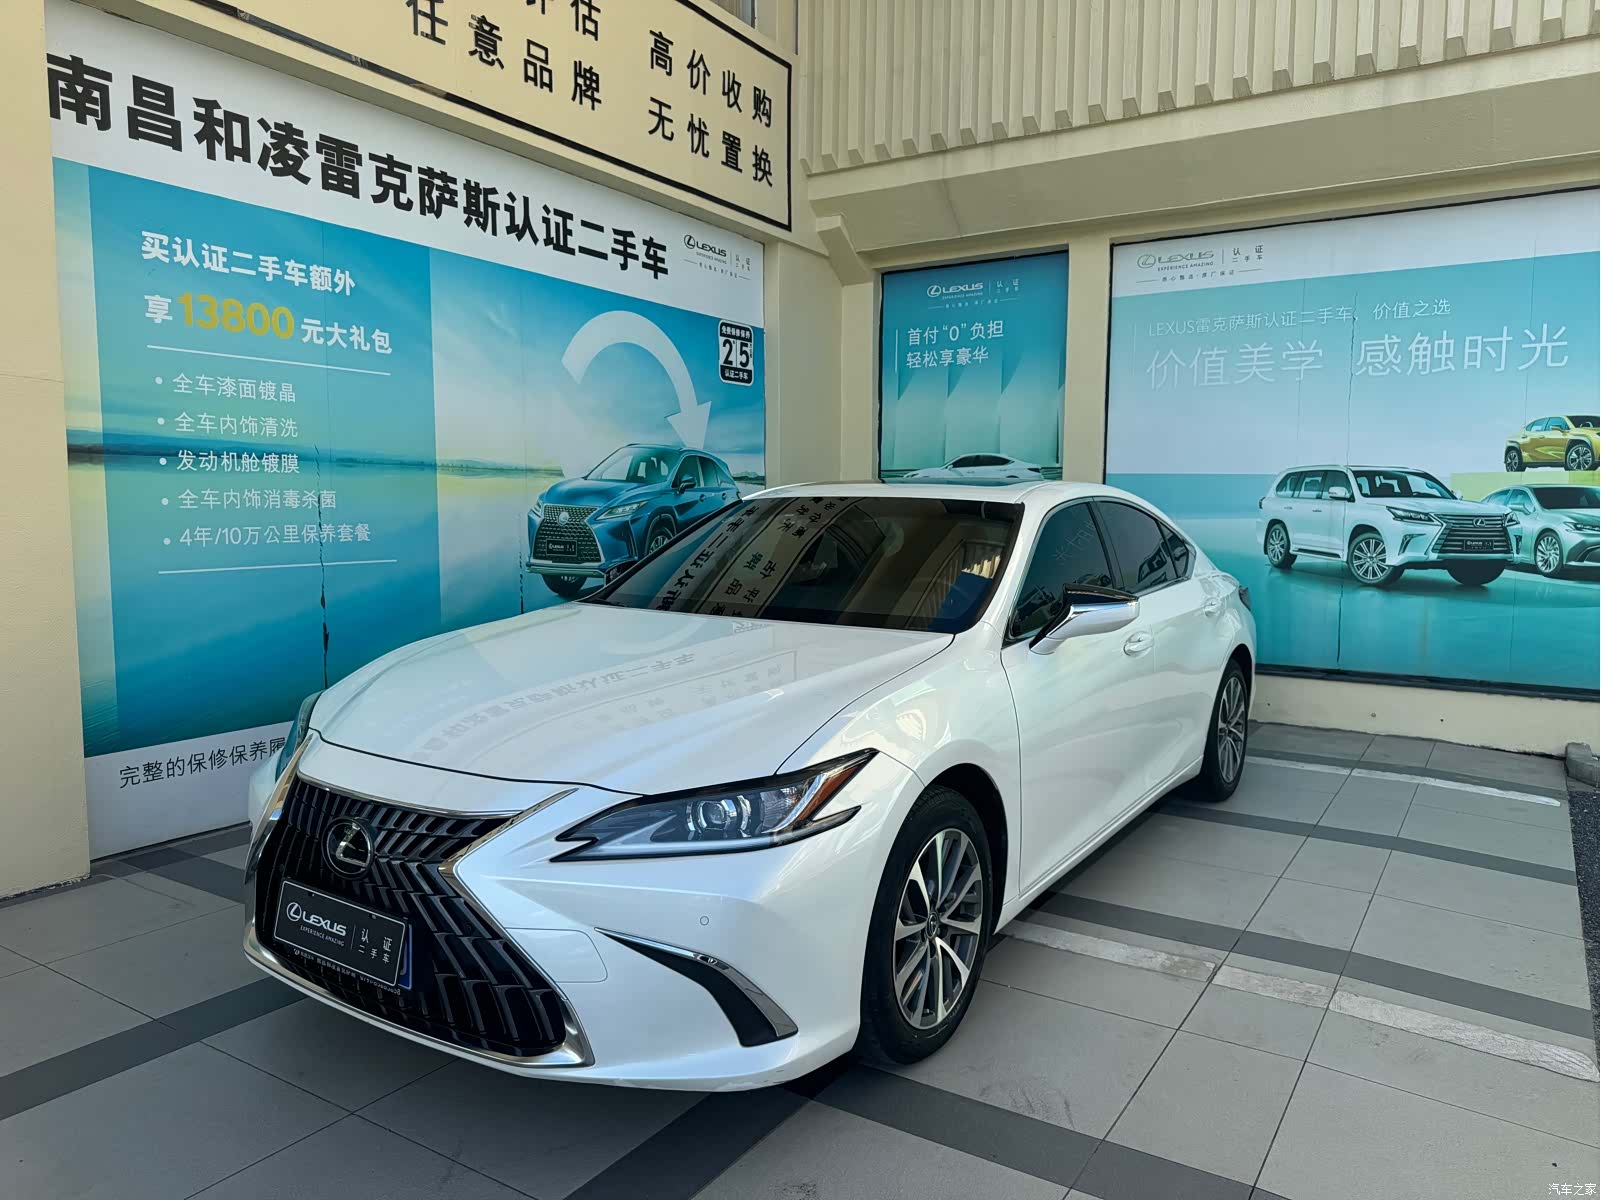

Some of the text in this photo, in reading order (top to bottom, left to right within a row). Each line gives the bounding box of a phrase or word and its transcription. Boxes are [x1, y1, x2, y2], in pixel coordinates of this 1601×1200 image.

[649, 30, 772, 128] 高价收购
[406, 0, 773, 187] 任意品牌 无忧置换
[46, 53, 669, 280] 南昌和凌雷克萨斯认证二手车
[696, 240, 727, 257] LEXUS
[1158, 250, 1214, 263] LEXUS
[141, 231, 356, 296] 买认证二手车额外
[943, 282, 983, 293] LEXUS
[1373, 298, 1450, 320] 价值之选
[145, 292, 392, 354] 享 13800 元大礼包
[906, 346, 989, 369] 轻松享豪华
[1147, 323, 1568, 390] 价值美学 感触时光
[172, 372, 296, 402] 全车漆面镀晶
[174, 411, 298, 438] 全车内饰清洗
[176, 449, 300, 474] 发动机舱镀膜
[177, 488, 337, 510] 全车内饰消毒杀菌
[179, 522, 371, 547] 4年/10万公里保养套餐
[302, 910, 347, 936] LEXUS
